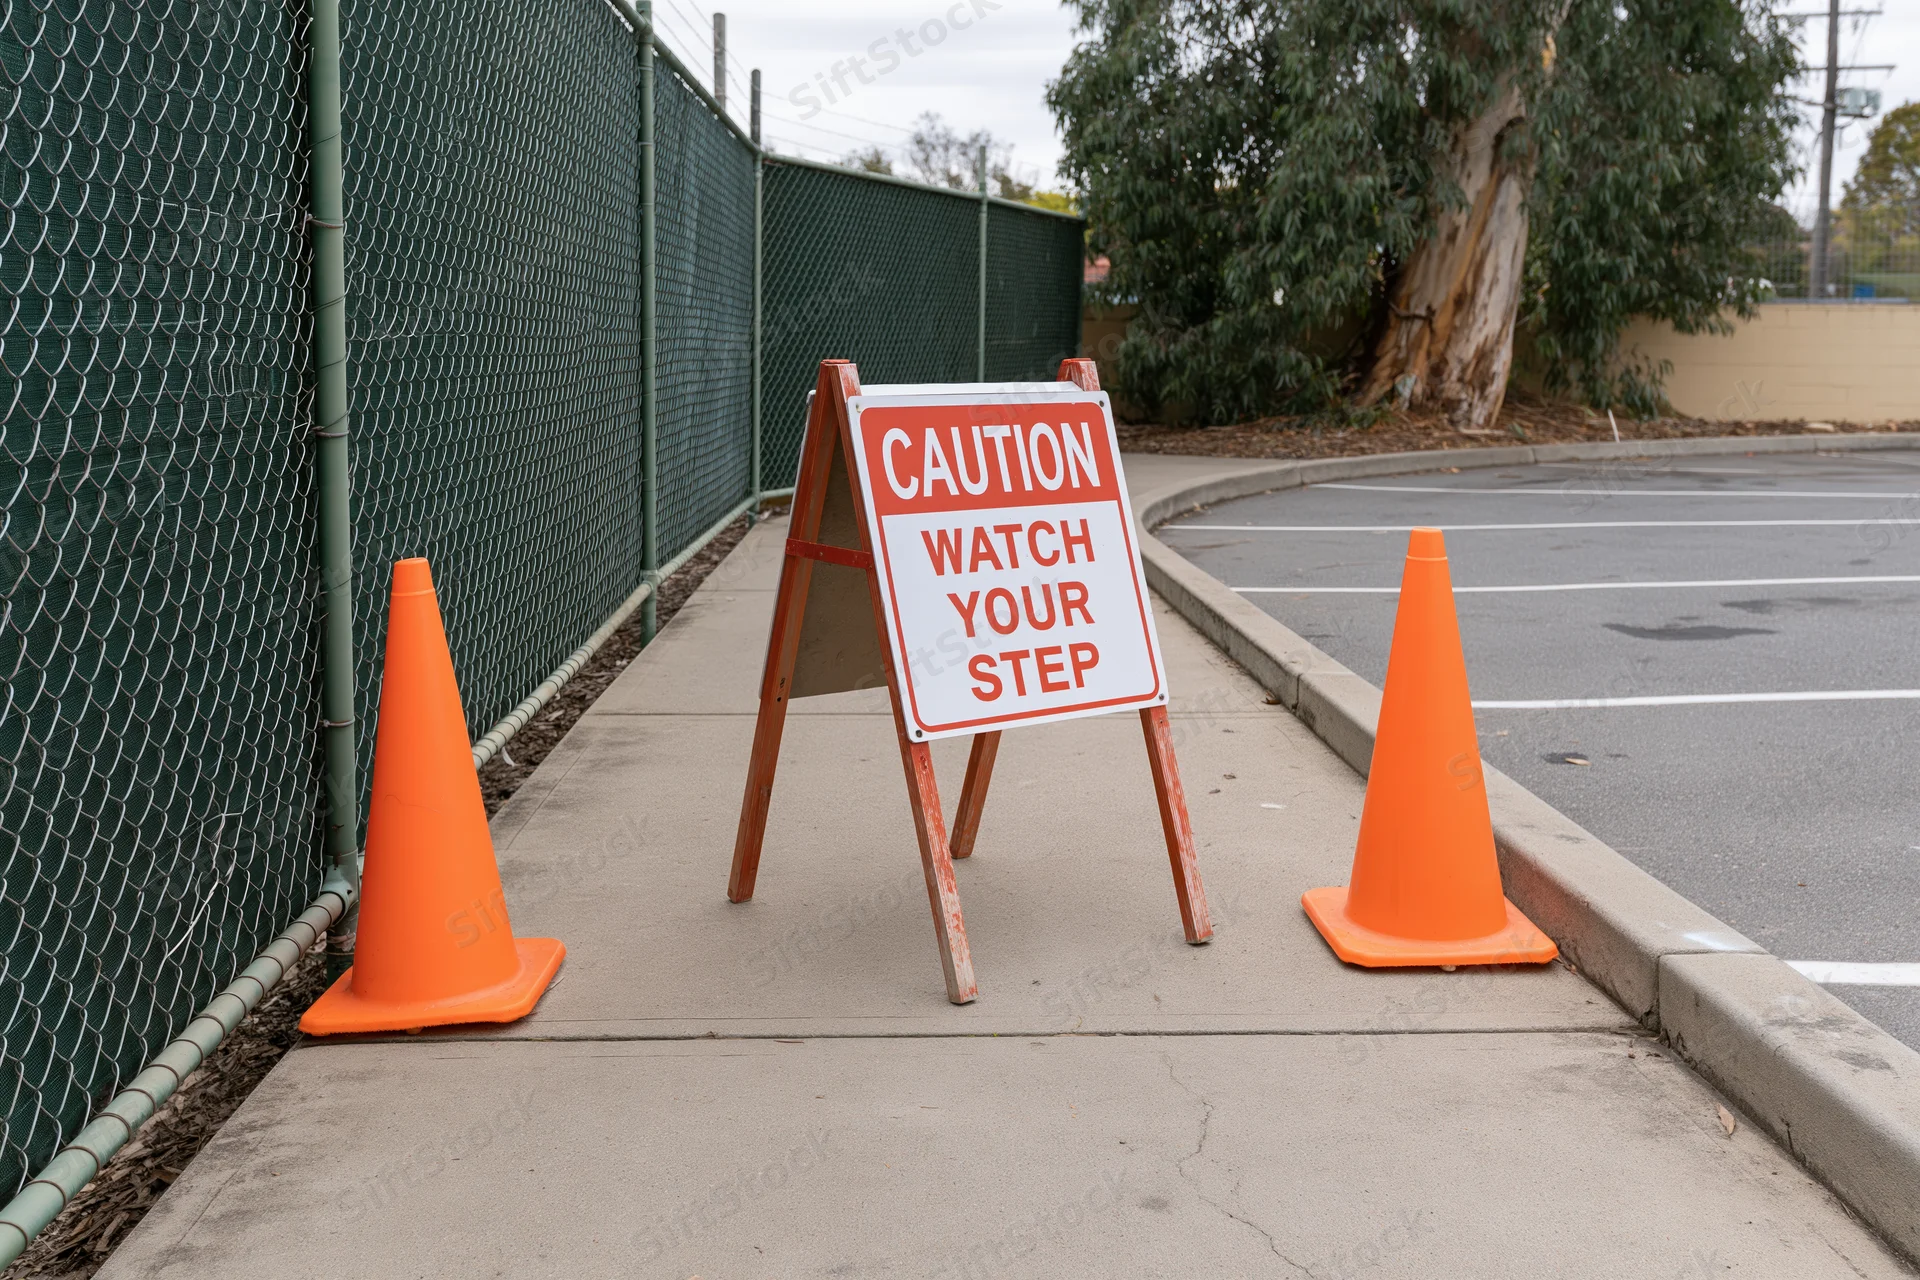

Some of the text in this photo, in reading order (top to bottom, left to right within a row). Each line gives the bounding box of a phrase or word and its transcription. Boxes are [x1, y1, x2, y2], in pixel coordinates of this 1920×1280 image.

[882, 422, 1101, 500] CAUTION
[920, 518, 1095, 577] WATCH
[947, 581, 1095, 638] YOUR
[967, 641, 1100, 702] STEP
